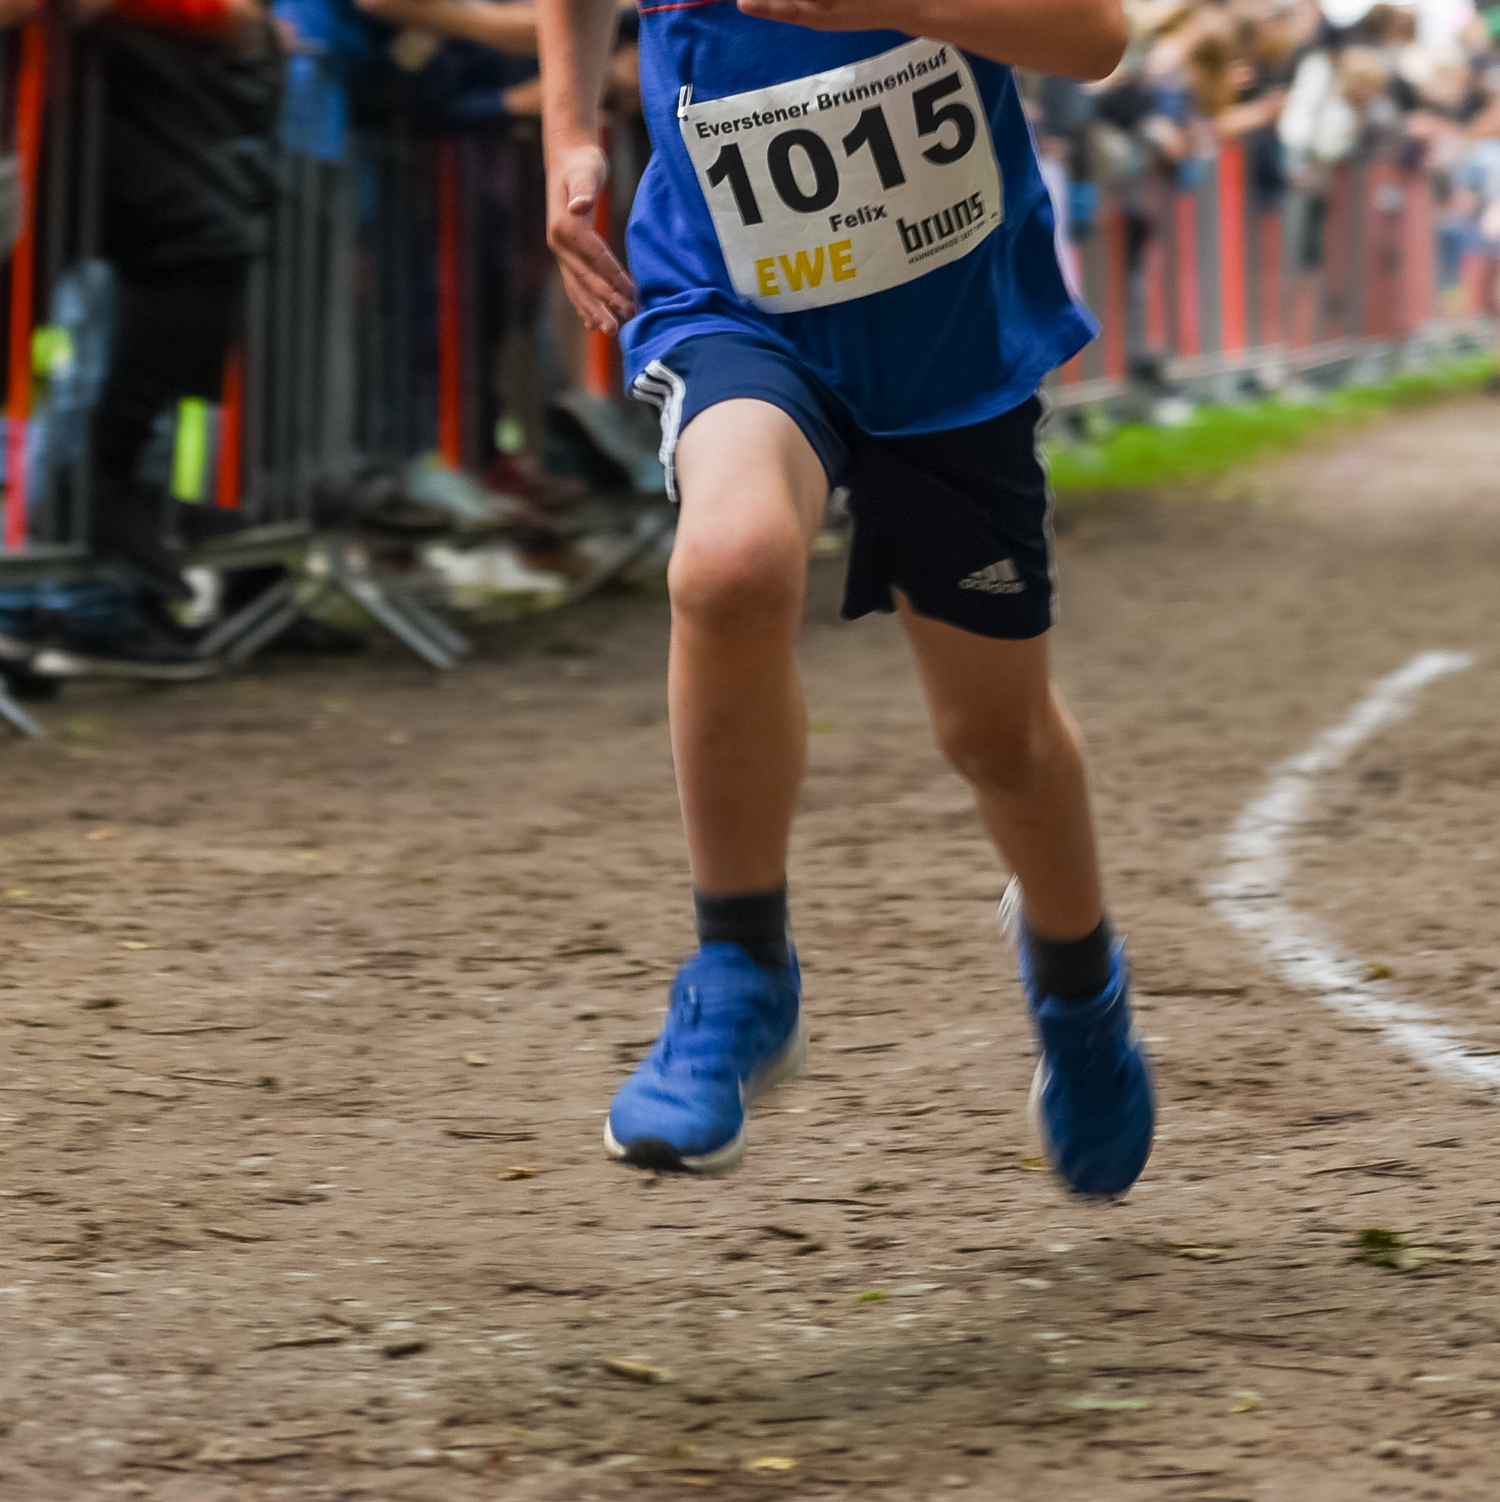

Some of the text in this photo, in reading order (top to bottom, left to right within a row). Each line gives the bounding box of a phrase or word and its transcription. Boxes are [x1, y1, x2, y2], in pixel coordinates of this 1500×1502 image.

[695, 47, 948, 139] Everstener Brunnenlauf
[705, 71, 976, 227] 1015
[828, 203, 888, 233] Felix
[896, 190, 984, 255] bruns
[754, 239, 857, 297] EWE
